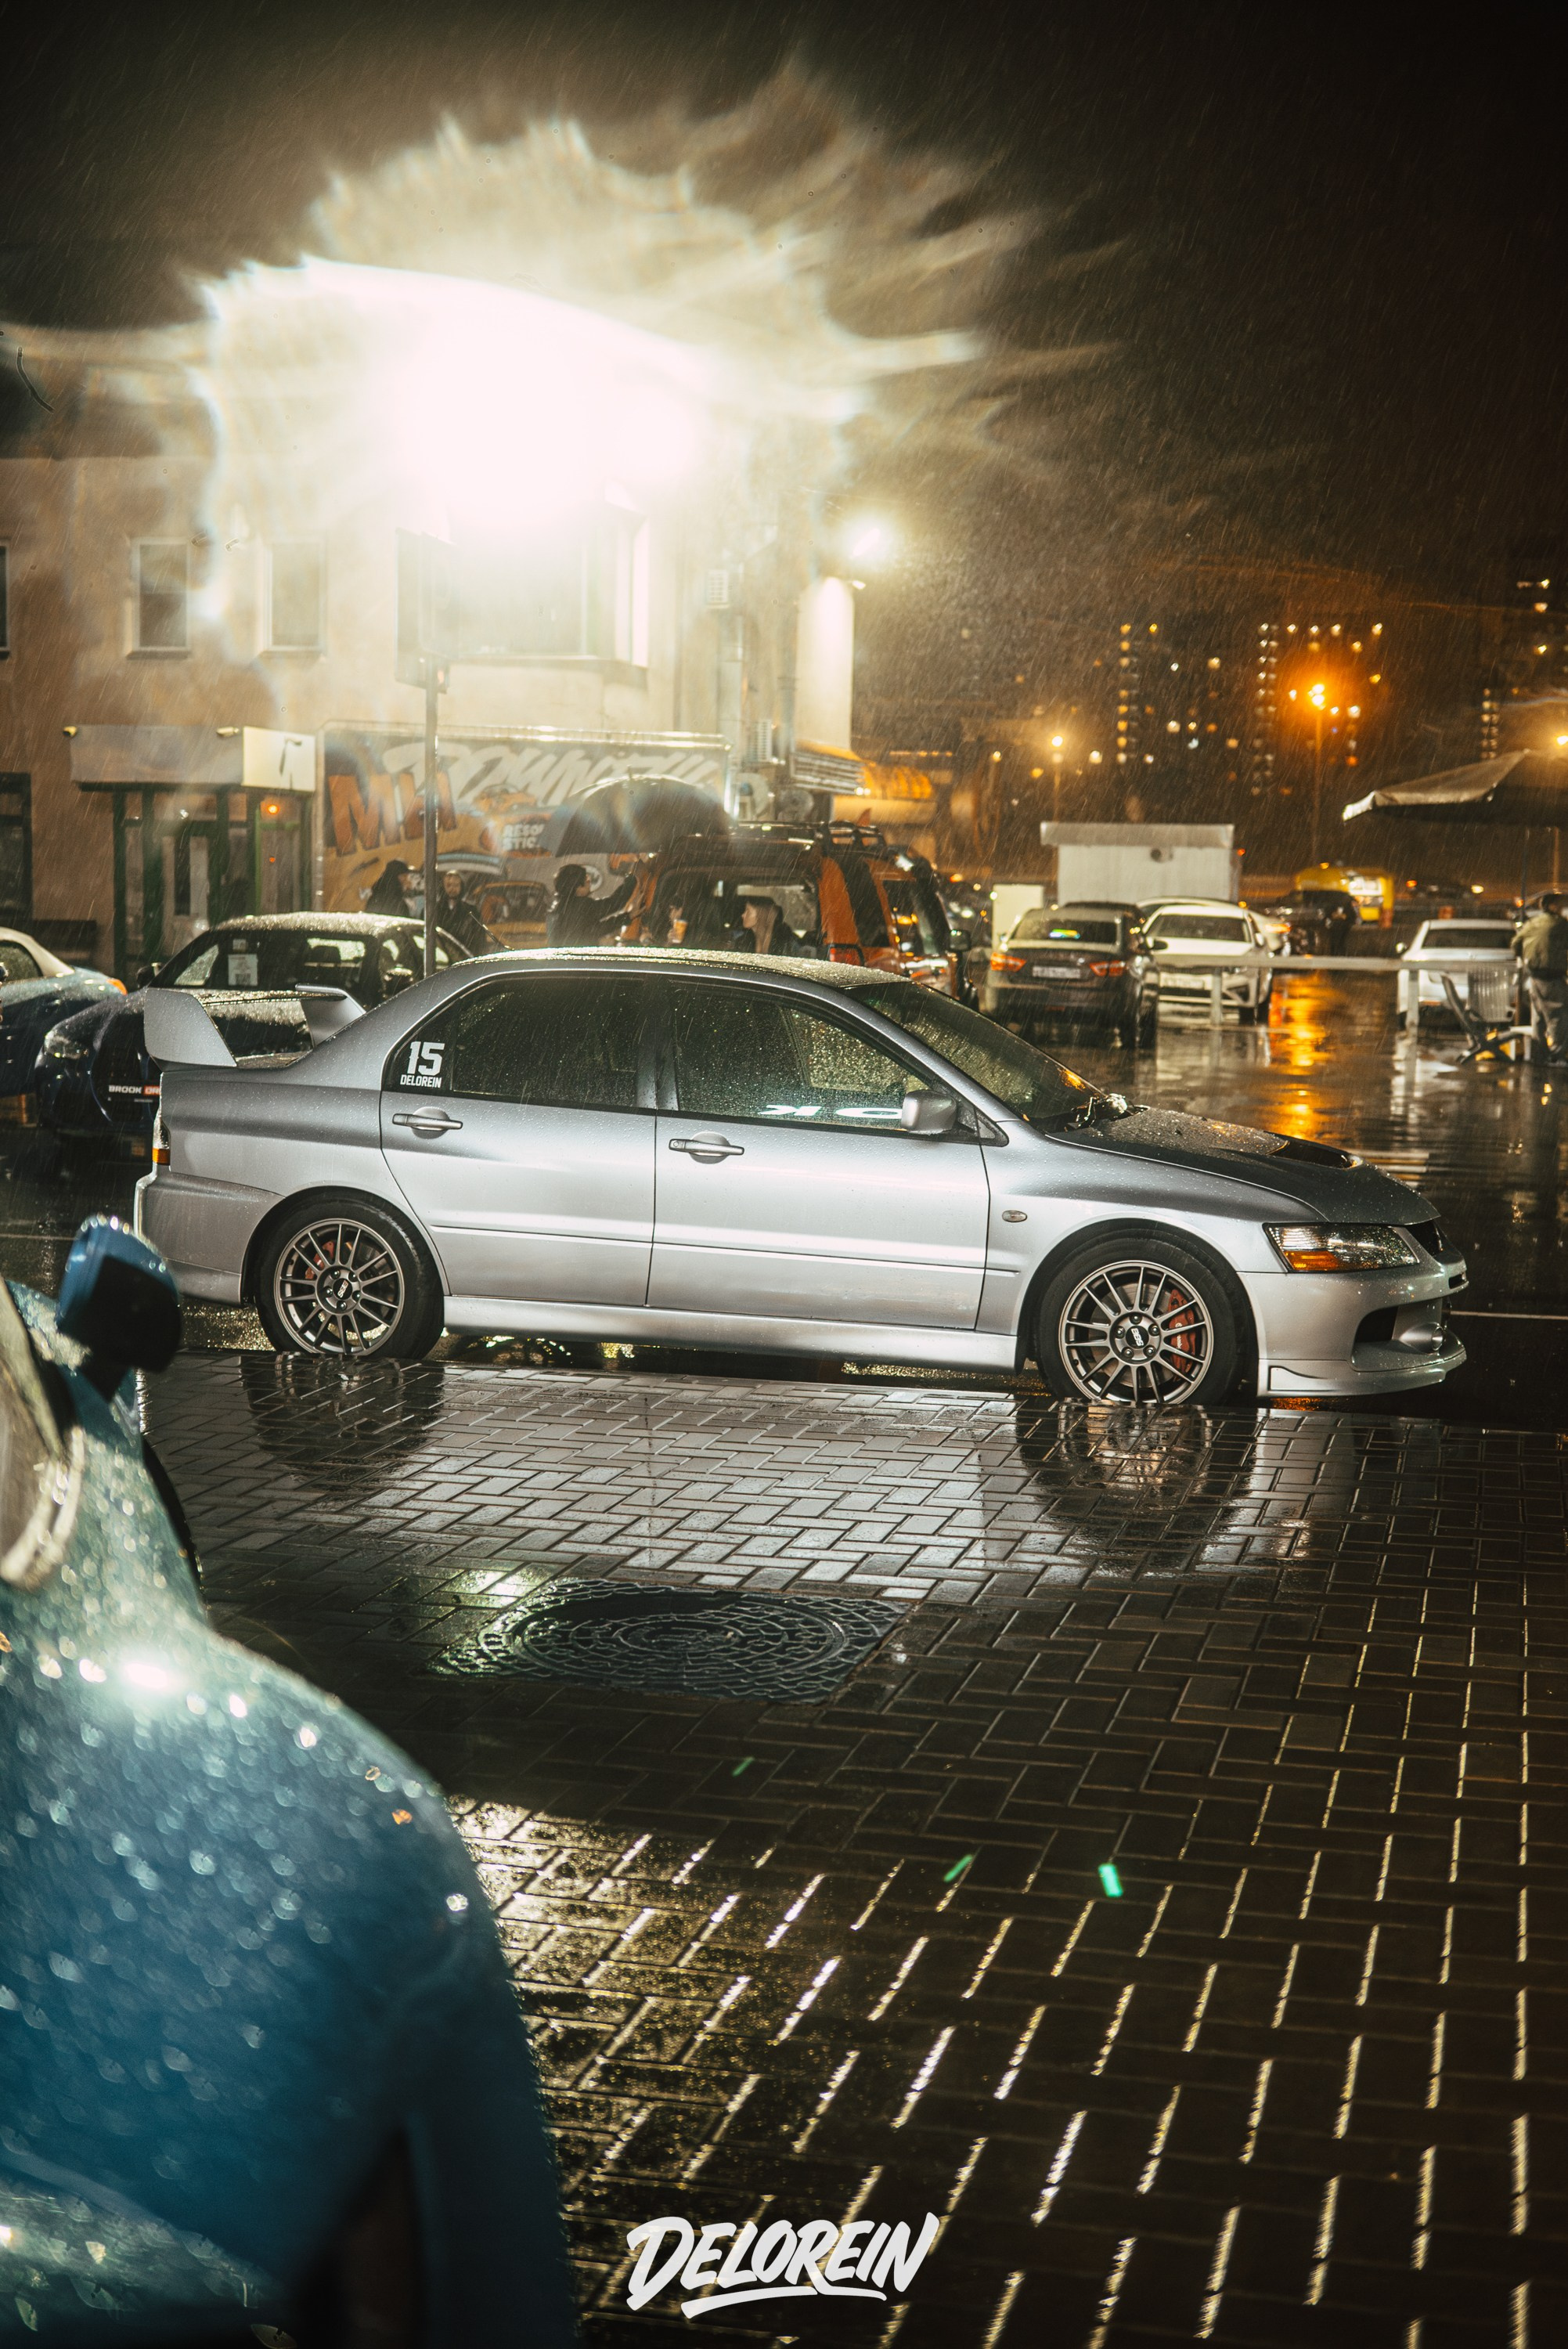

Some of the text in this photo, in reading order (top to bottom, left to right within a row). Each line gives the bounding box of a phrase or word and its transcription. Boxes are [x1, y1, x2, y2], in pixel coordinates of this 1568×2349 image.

[407, 1041, 445, 1076] 15
[400, 1074, 442, 1088] DELOREIN
[109, 1085, 142, 1094] BROOK
[1130, 1328, 1144, 1346] BBS
